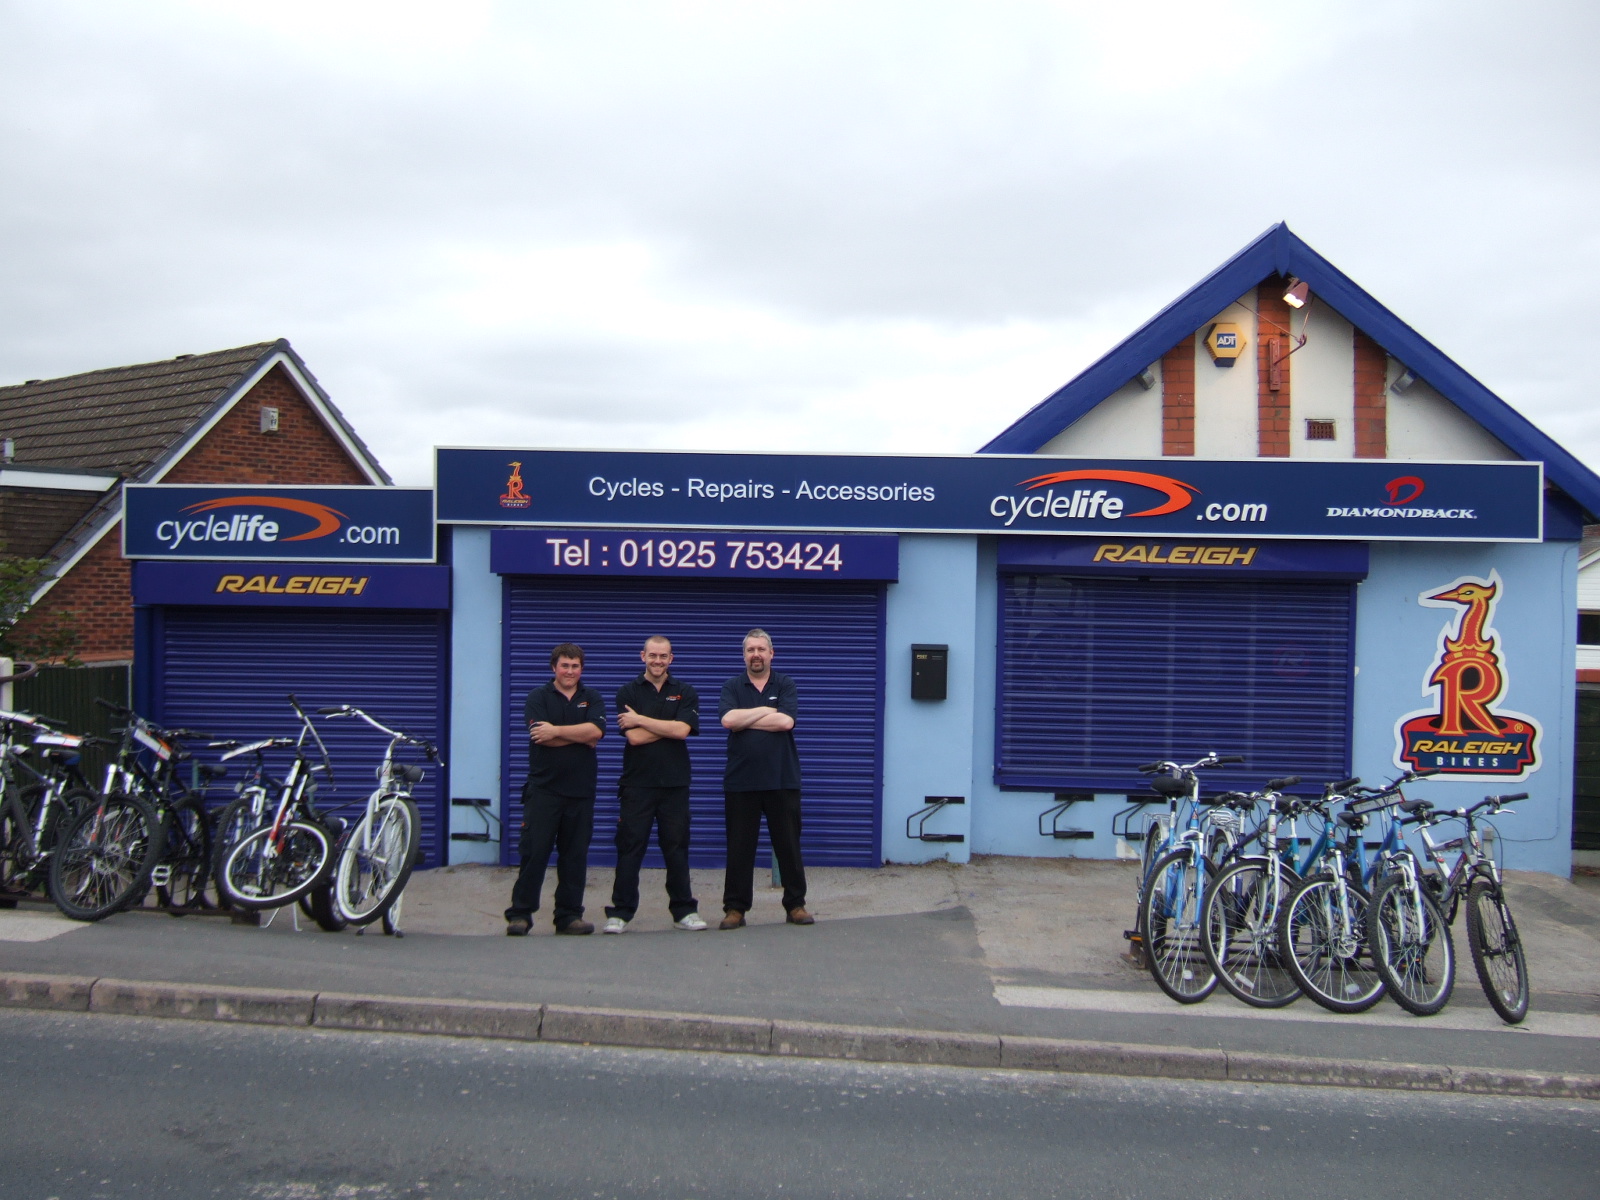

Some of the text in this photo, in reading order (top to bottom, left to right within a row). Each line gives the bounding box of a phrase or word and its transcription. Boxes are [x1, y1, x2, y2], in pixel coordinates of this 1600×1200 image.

[1217, 335, 1236, 346] ADT
[588, 476, 664, 501] Cycles
[687, 478, 775, 503] Repairs
[795, 480, 936, 503] Accessories
[990, 489, 1268, 526] cyclelife .com
[156, 514, 400, 550] cyclelife .com
[545, 538, 590, 567] Tel
[619, 539, 716, 569] 01925
[726, 541, 843, 572] 753424
[1092, 544, 1257, 566] RALEIGH
[215, 575, 369, 595] RALEIGH
[1429, 657, 1500, 736] R
[1412, 740, 1523, 755] RALEIGH
[1436, 757, 1499, 767] BIKES
